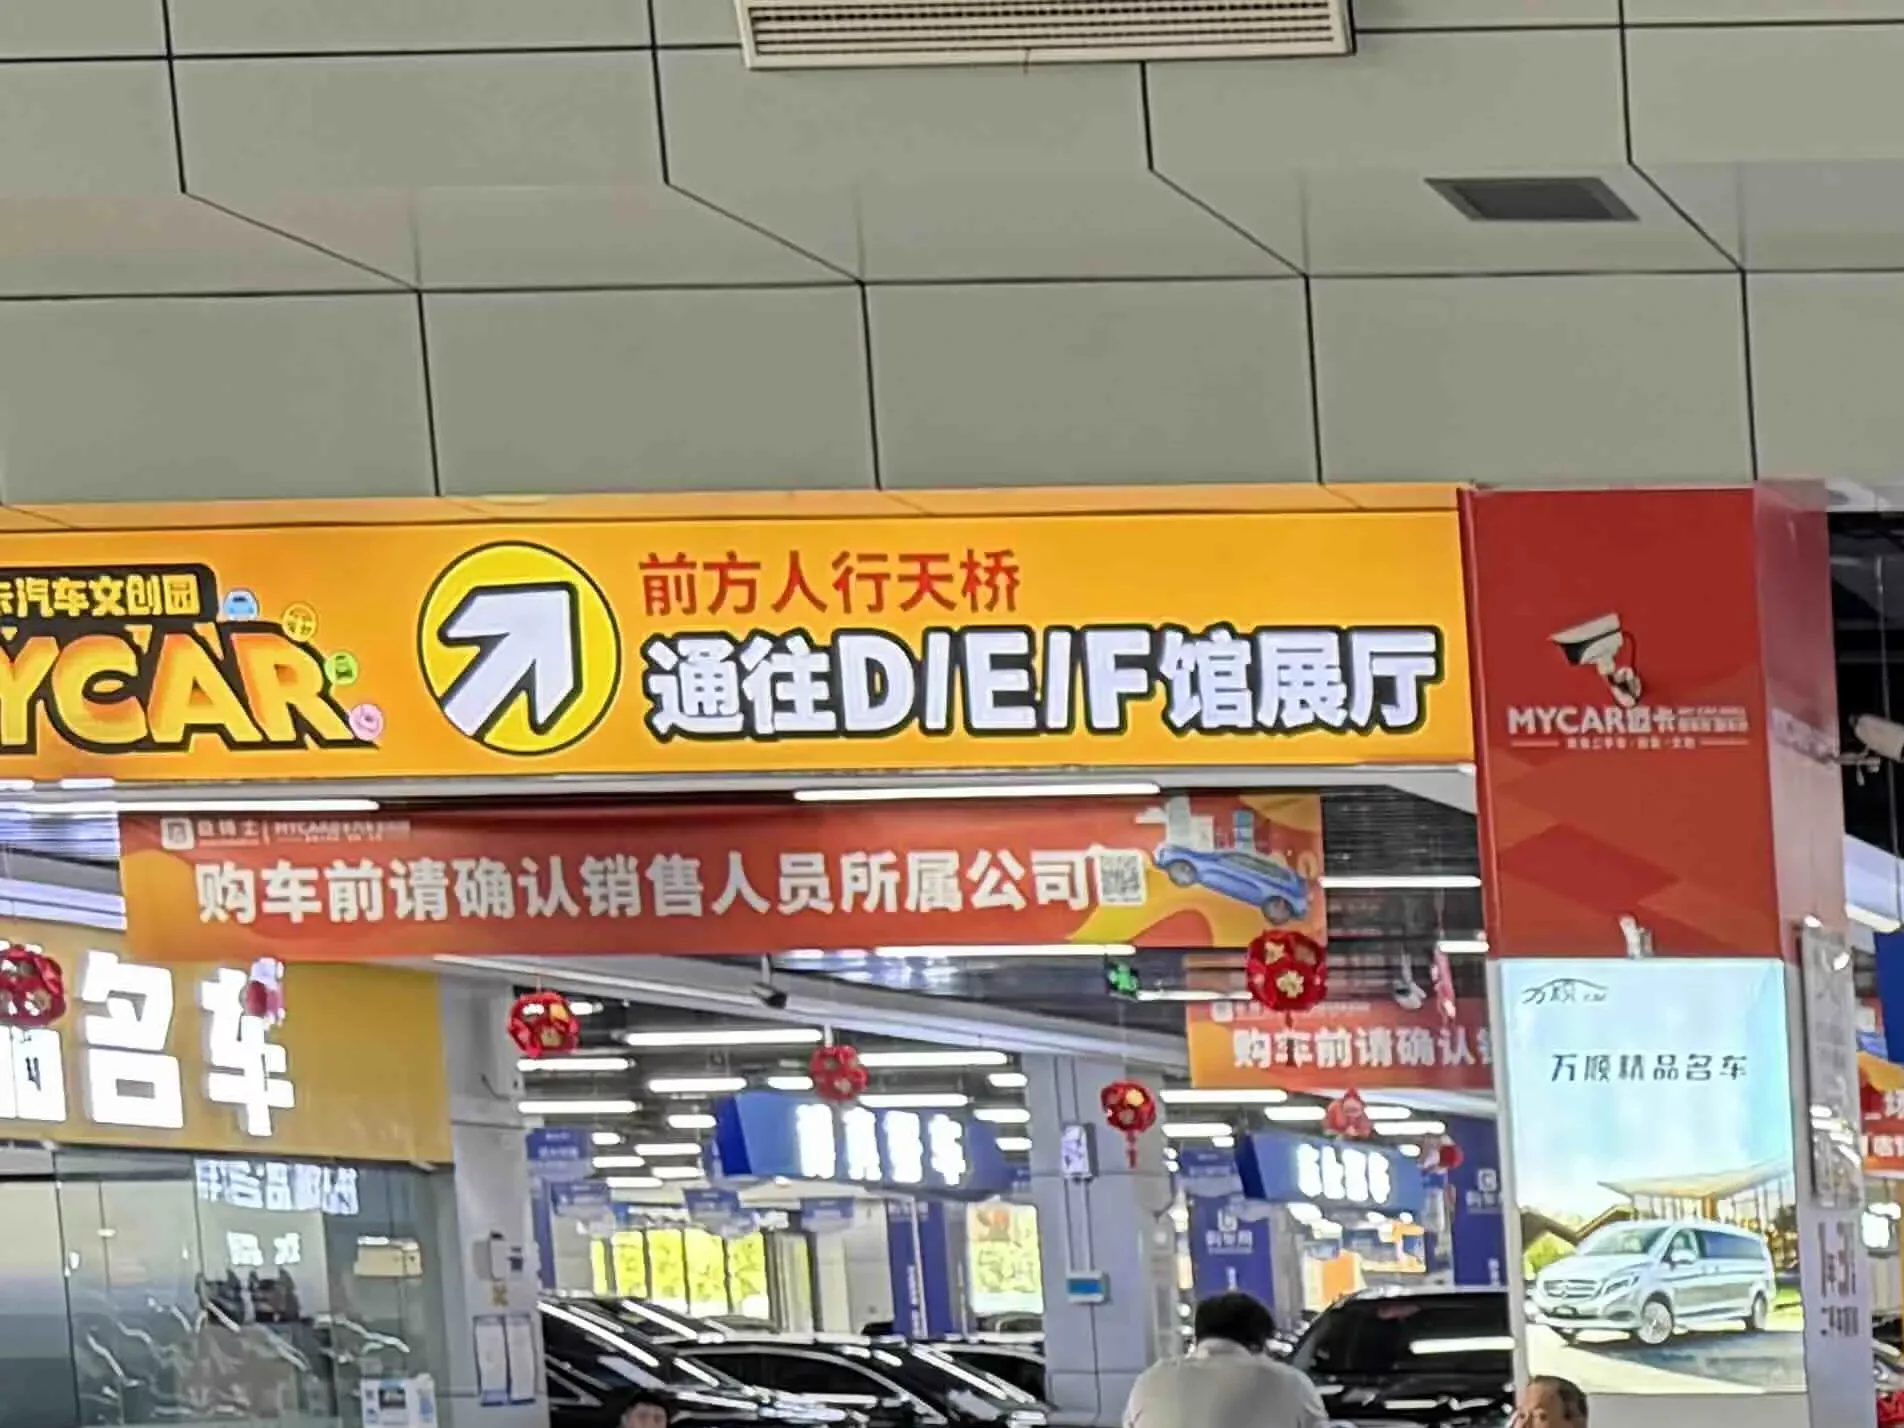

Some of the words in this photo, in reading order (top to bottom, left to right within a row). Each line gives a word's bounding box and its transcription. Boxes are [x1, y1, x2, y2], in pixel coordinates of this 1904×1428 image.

[0, 574, 199, 616] 汽车文创园
[640, 548, 1021, 617] 前方人行天桥
[647, 626, 1440, 740] 通往D/E/F馆展厅
[195, 848, 1092, 926] 购车前请确认销售人员所属公司
[1551, 1053, 1749, 1083] 万顺精品名车
